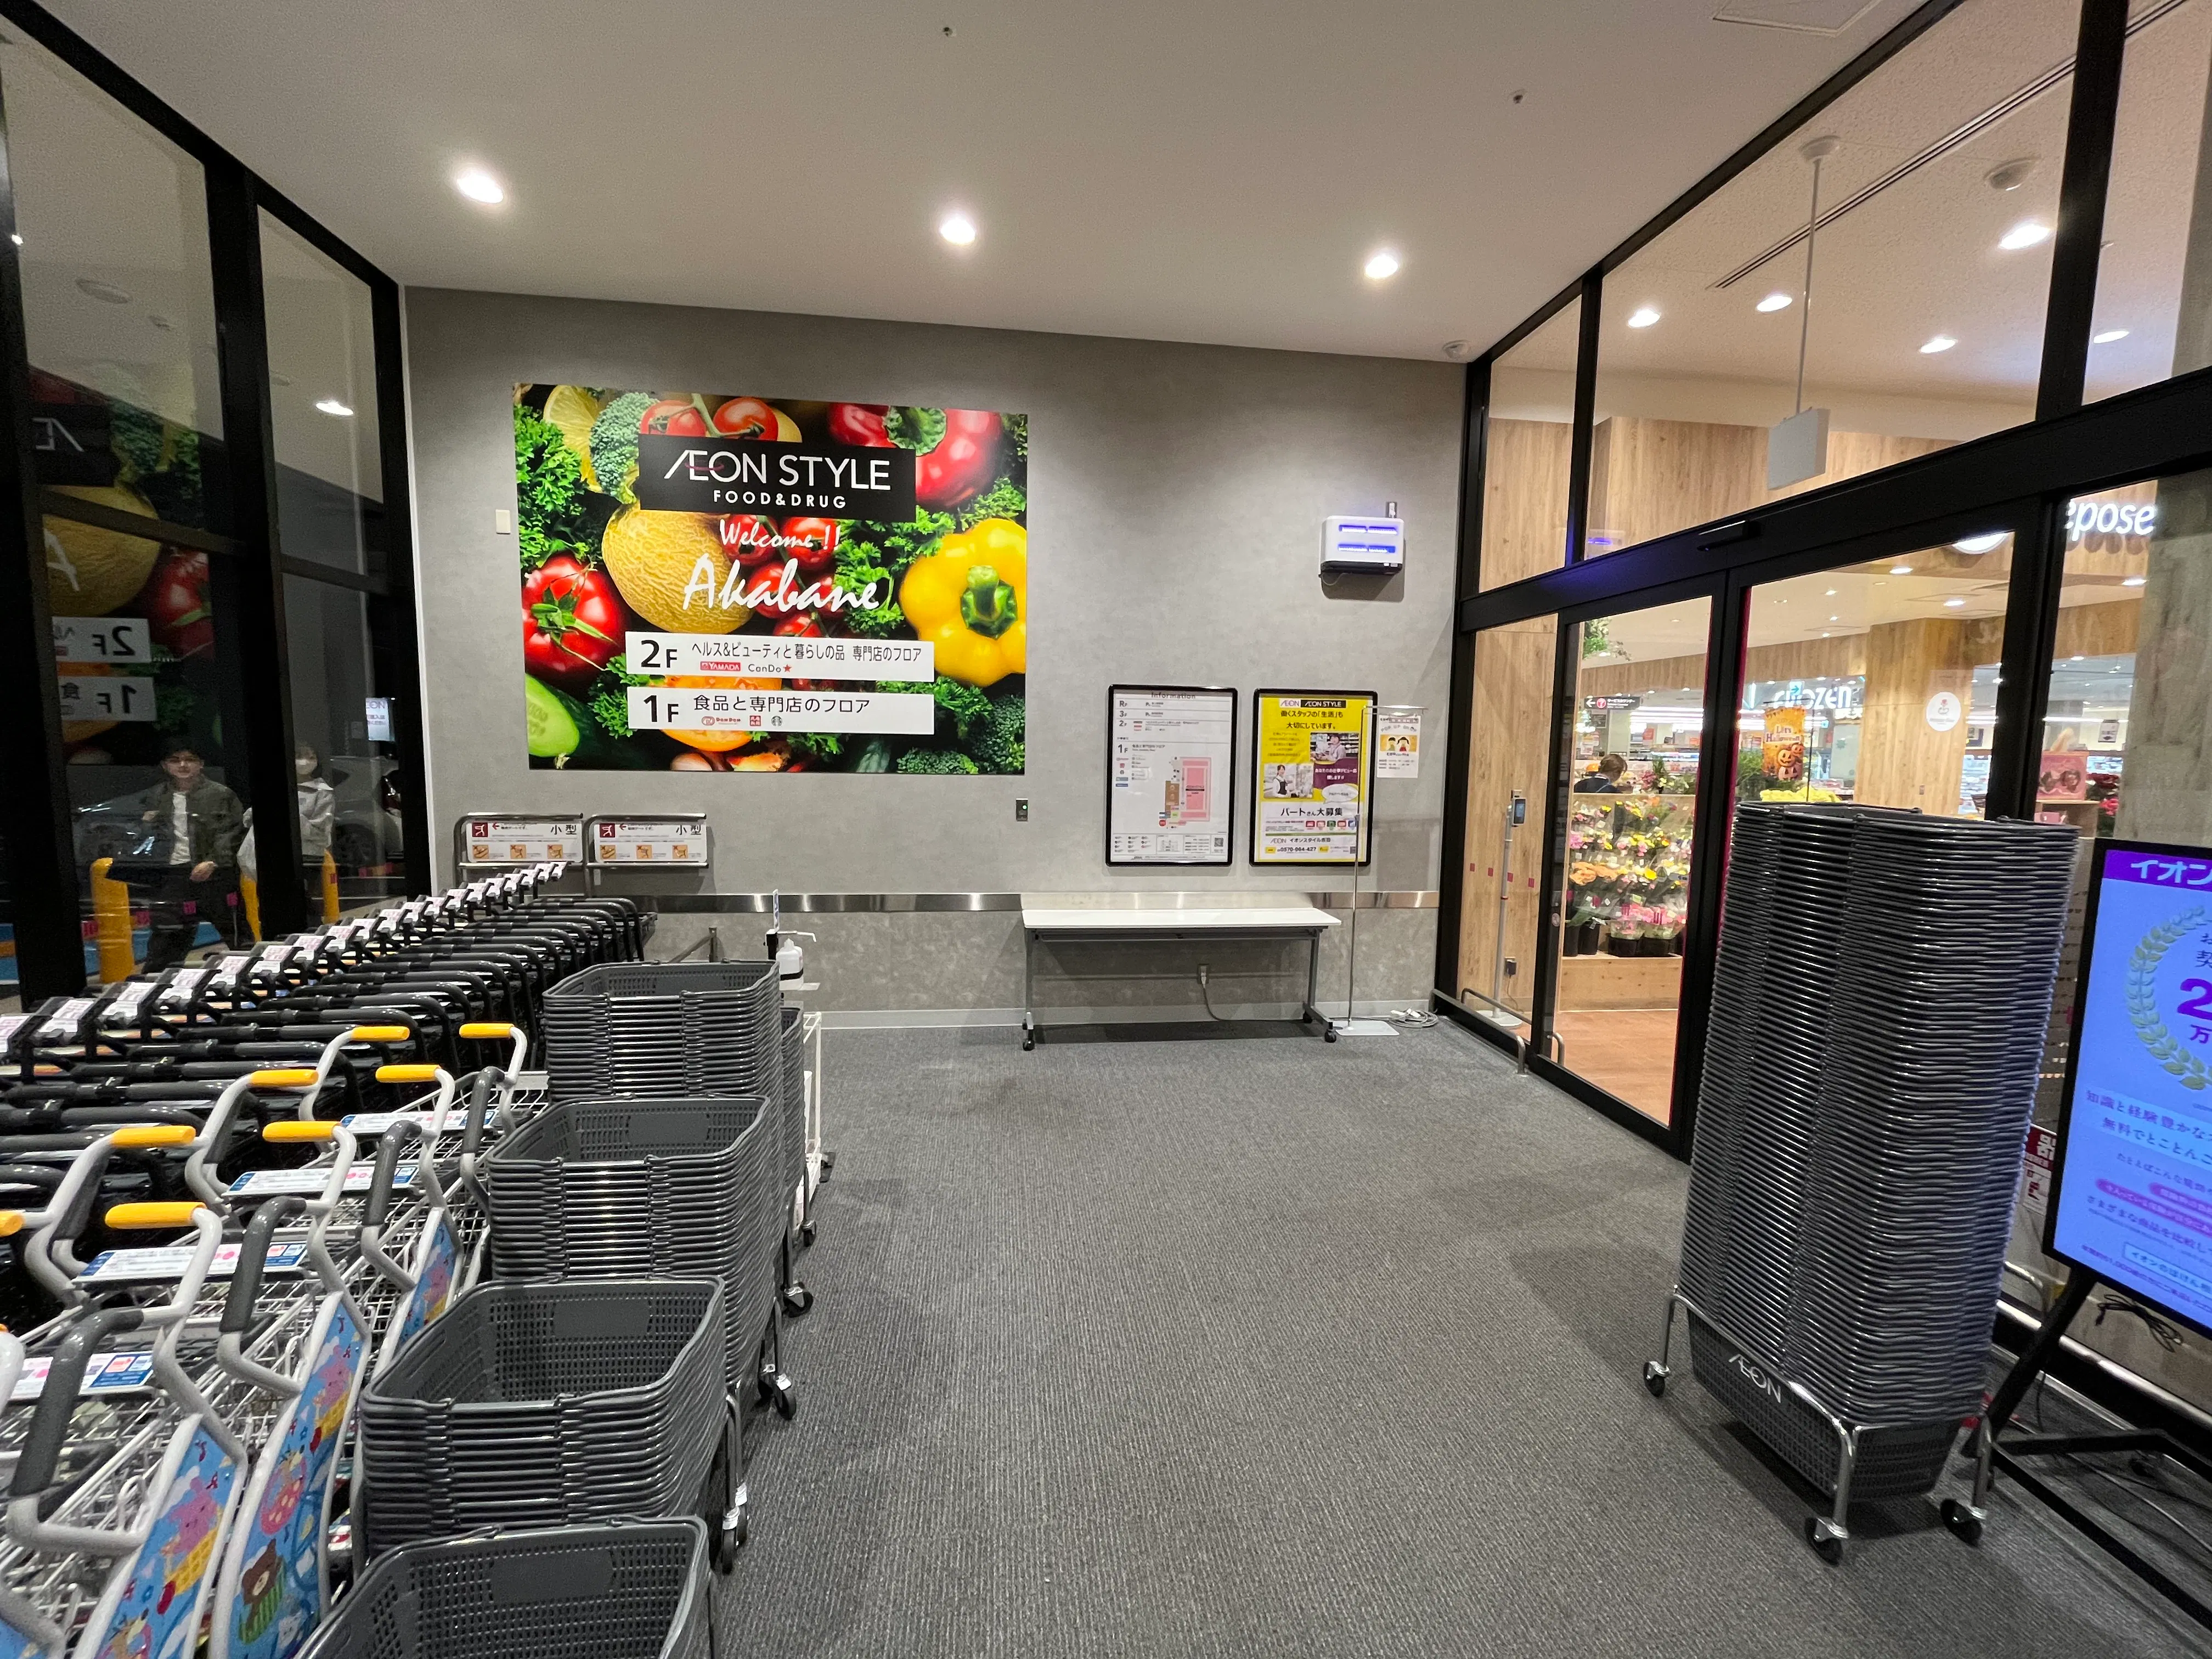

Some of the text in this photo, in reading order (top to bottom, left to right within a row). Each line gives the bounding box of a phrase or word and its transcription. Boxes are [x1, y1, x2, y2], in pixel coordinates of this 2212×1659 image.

[779, 455, 891, 490] STYLE
[714, 490, 846, 509] FOOD&DRUG
[719, 519, 841, 550] Welcome !!
[682, 553, 879, 613] Akabane
[641, 640, 678, 668] 2F
[853, 646, 921, 662] 専門店のフロア
[709, 662, 781, 673] YAMADA CanDo
[644, 695, 679, 723] 1F
[693, 695, 870, 713] 食品と専門店のフロア
[1280, 808, 1342, 816] パートさん大募集
